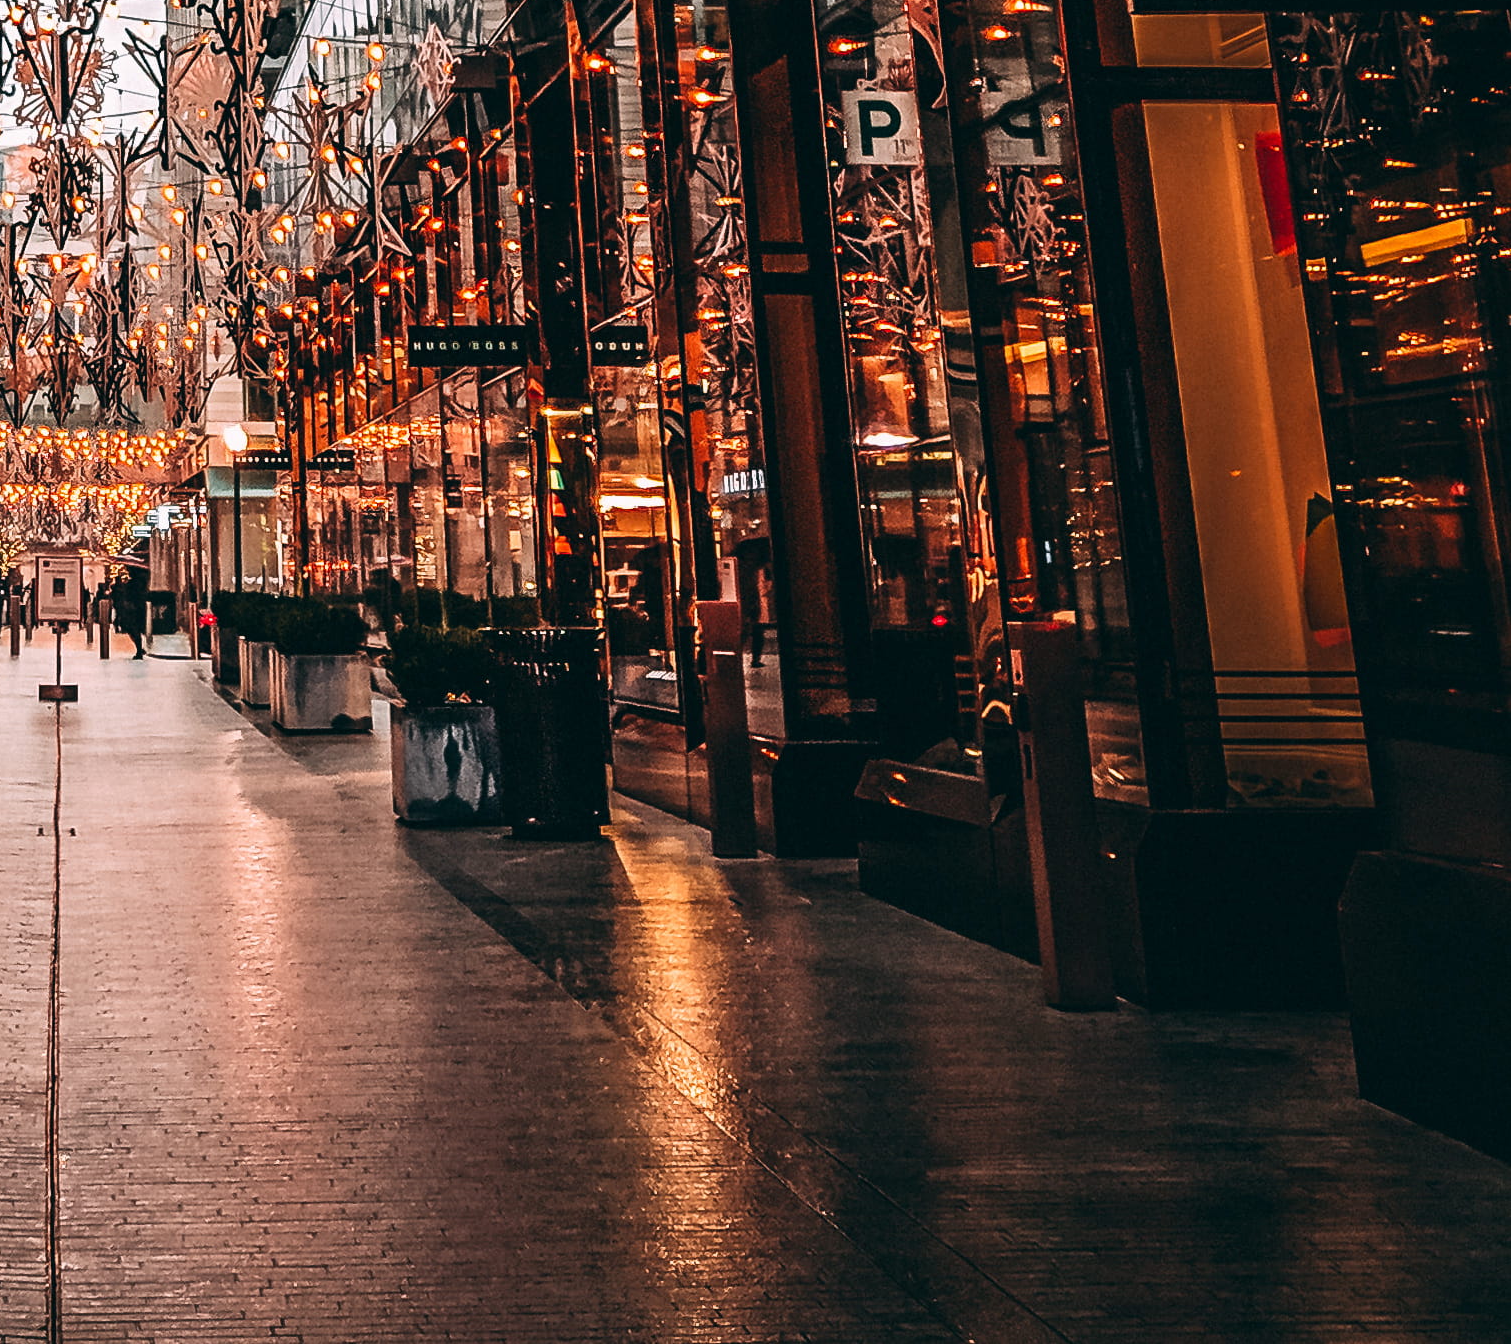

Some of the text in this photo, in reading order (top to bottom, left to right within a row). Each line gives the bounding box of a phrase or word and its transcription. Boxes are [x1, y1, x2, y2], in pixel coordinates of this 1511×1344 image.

[857, 100, 901, 156] P
[413, 340, 518, 351] HUGO BOSS
